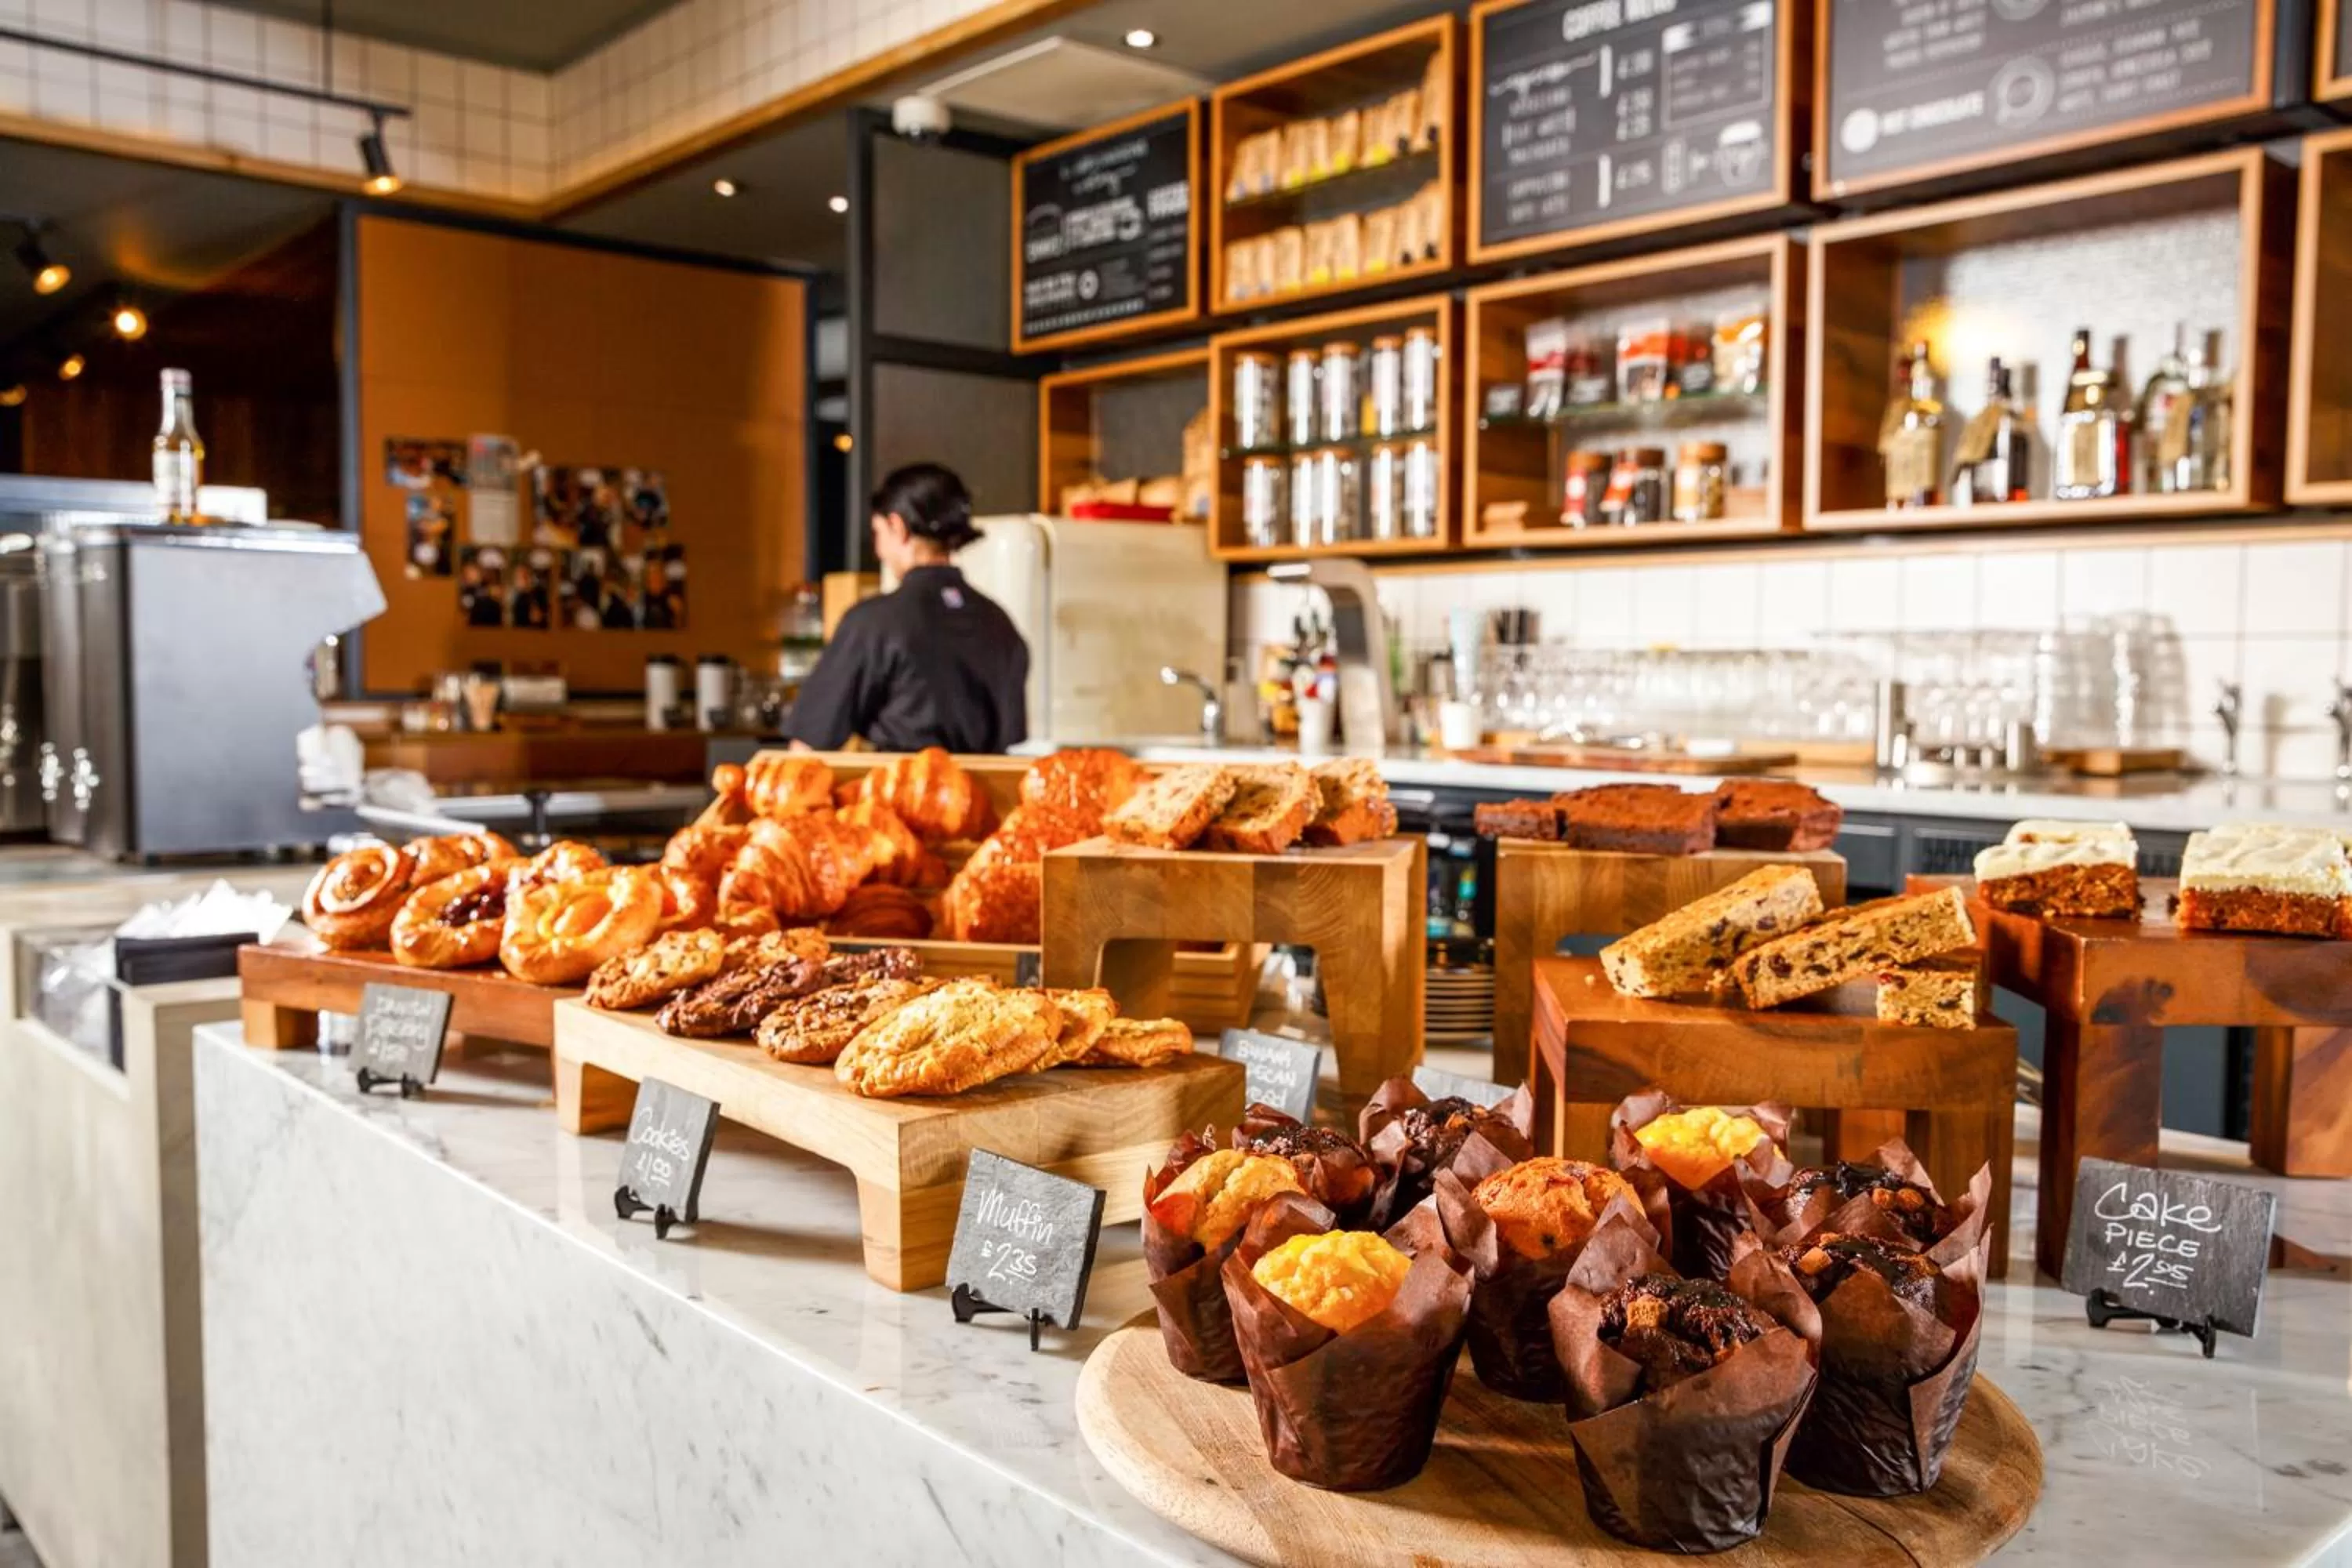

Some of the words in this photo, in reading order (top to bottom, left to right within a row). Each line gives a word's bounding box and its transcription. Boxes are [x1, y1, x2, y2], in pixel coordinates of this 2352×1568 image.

[630, 1106, 691, 1160] Cookies
[977, 1188, 1054, 1245] Muffin
[2094, 1181, 2223, 1233] Cake
[2105, 1222, 2201, 1258] PIECE
